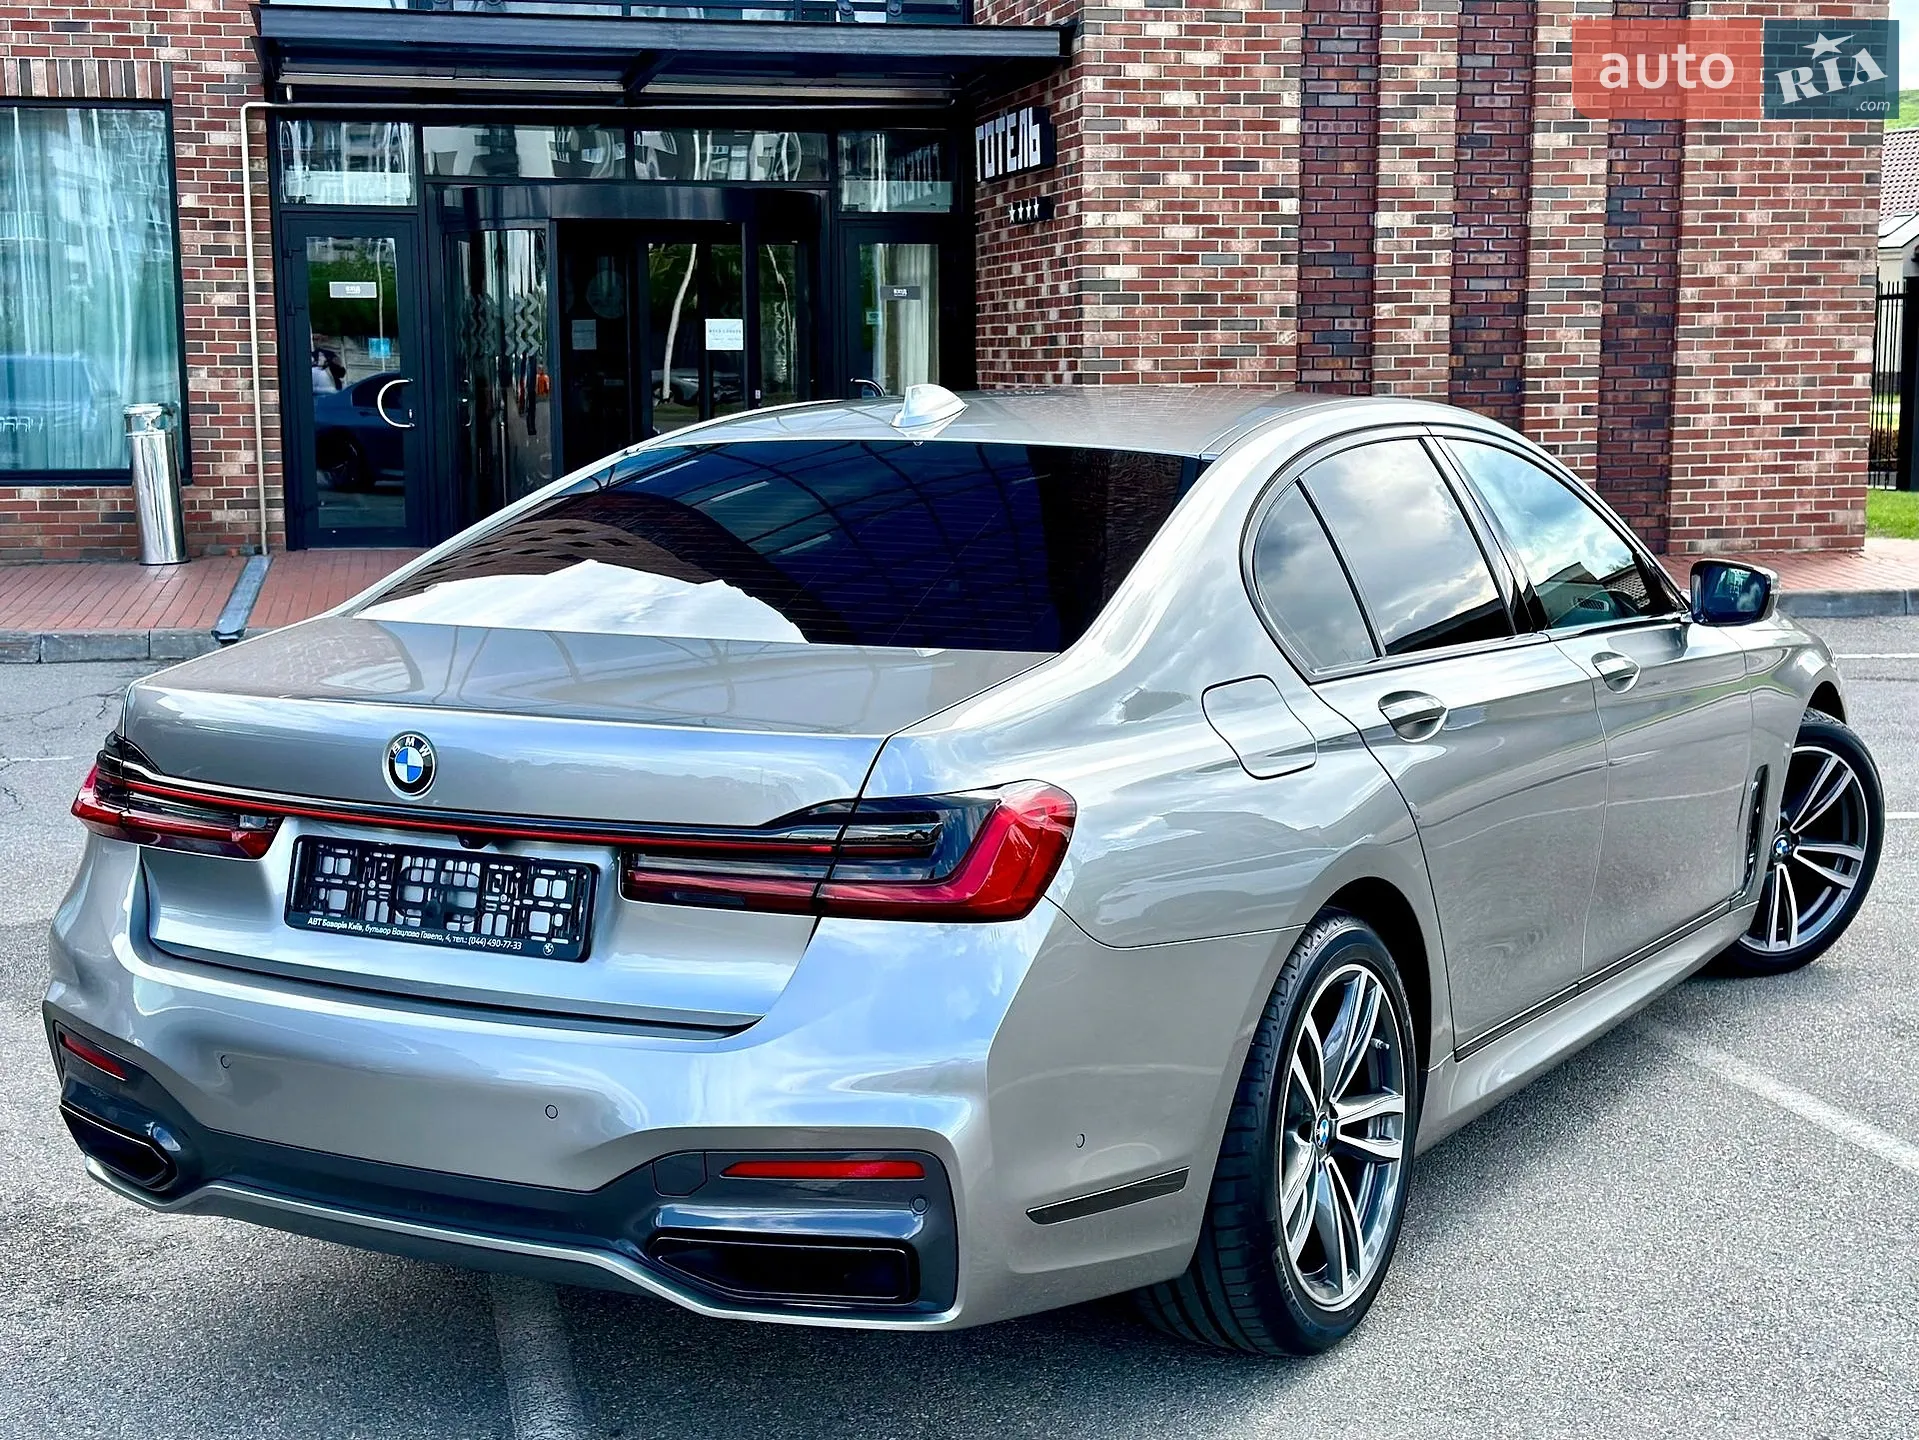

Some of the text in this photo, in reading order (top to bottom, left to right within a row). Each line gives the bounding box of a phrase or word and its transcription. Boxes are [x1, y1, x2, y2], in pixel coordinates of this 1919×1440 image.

[975, 106, 1041, 183] ГОТЕЛЬ
[392, 737, 431, 757] BMW
[365, 924, 391, 935] бульвар
[468, 936, 486, 947] (044)
[487, 938, 522, 950] 490-77-33
